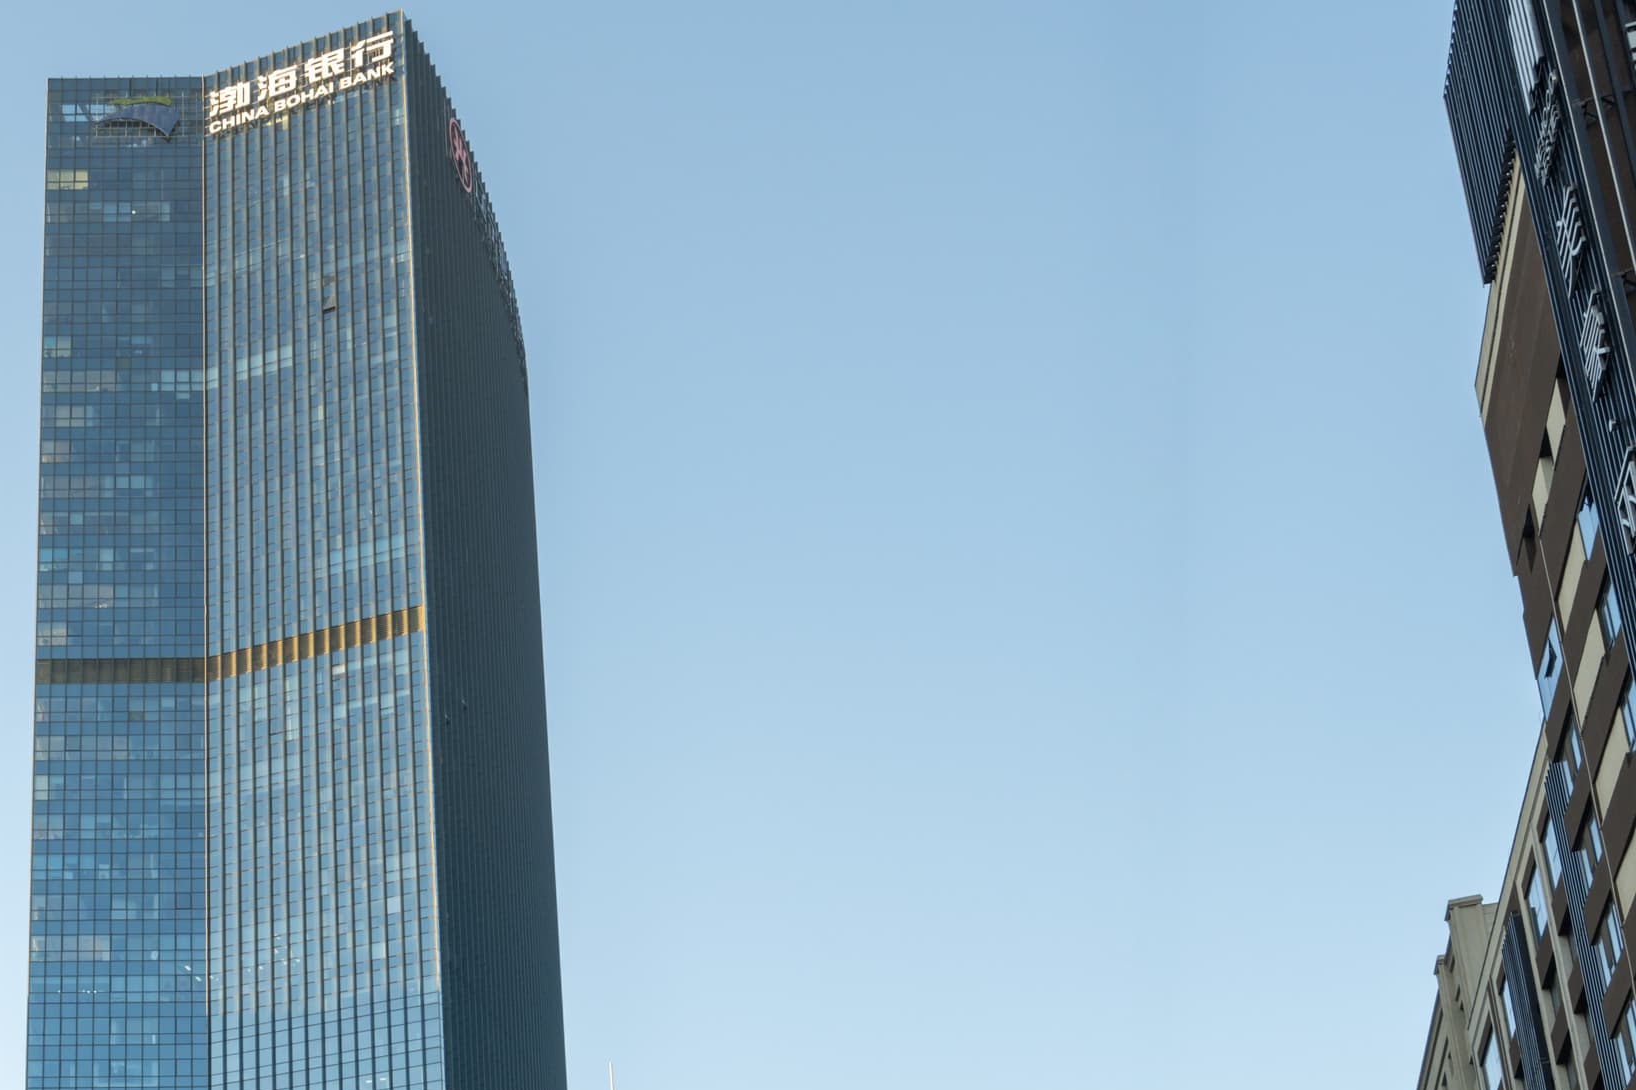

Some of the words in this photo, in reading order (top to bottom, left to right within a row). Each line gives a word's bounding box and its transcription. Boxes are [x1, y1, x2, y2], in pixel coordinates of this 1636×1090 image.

[209, 30, 395, 117] 渤海银行
[209, 105, 270, 134] CHINA
[274, 82, 335, 113] BOHAI
[339, 61, 395, 90] BANK
